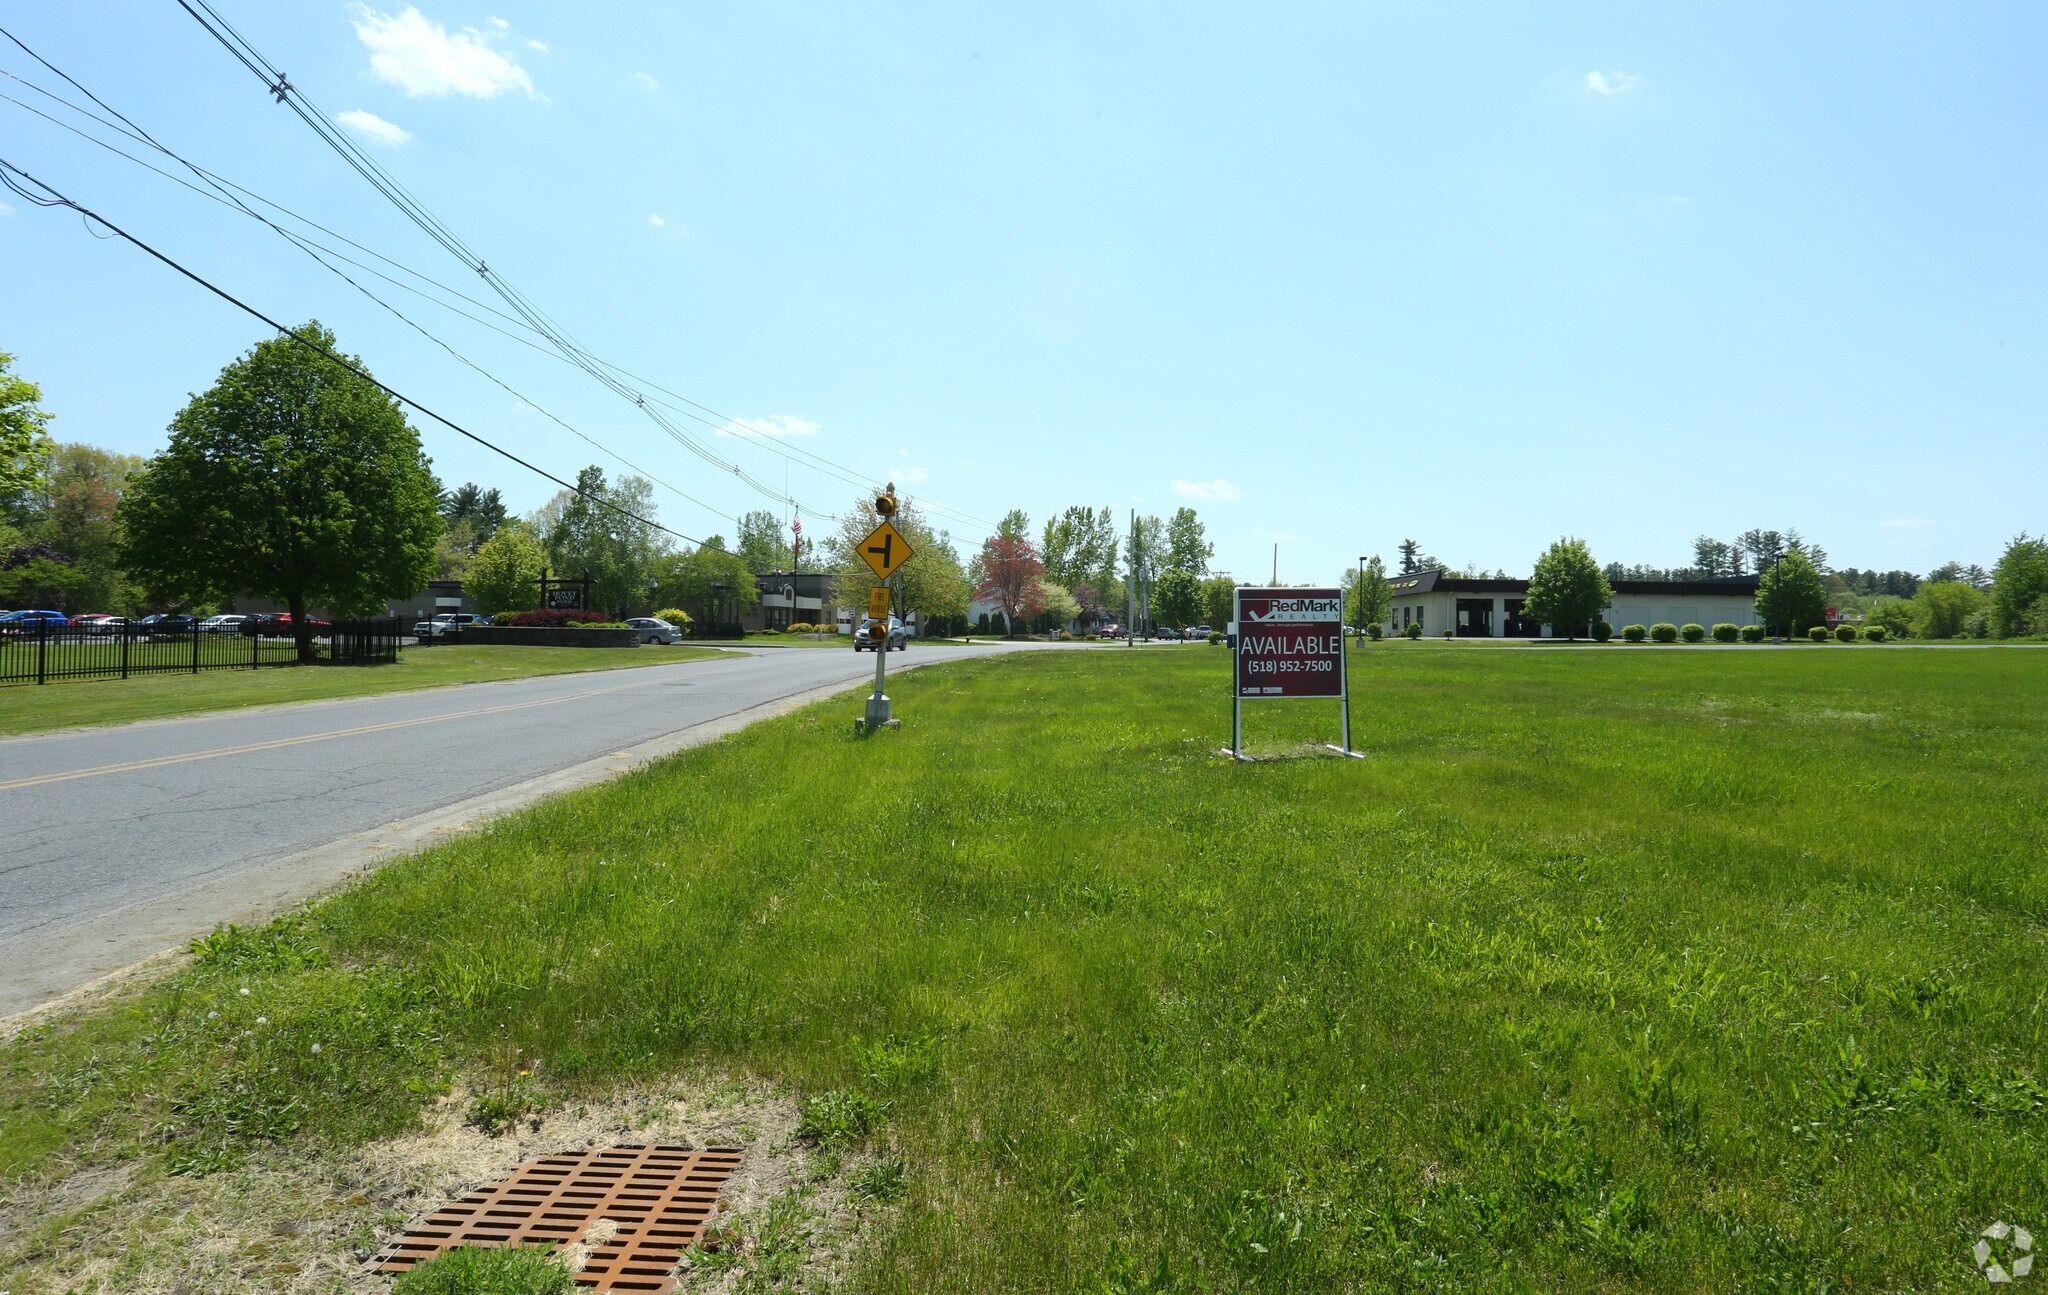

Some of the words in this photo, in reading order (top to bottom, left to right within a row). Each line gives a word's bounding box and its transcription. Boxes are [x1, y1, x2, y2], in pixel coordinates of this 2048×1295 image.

[874, 592, 885, 601] FIRE
[871, 604, 886, 614] HOUSE
[1270, 599, 1339, 612] RedMark
[1240, 636, 1340, 655] AVAILABLE
[1248, 660, 1277, 675] (518)
[1279, 660, 1333, 672] 952-7500
